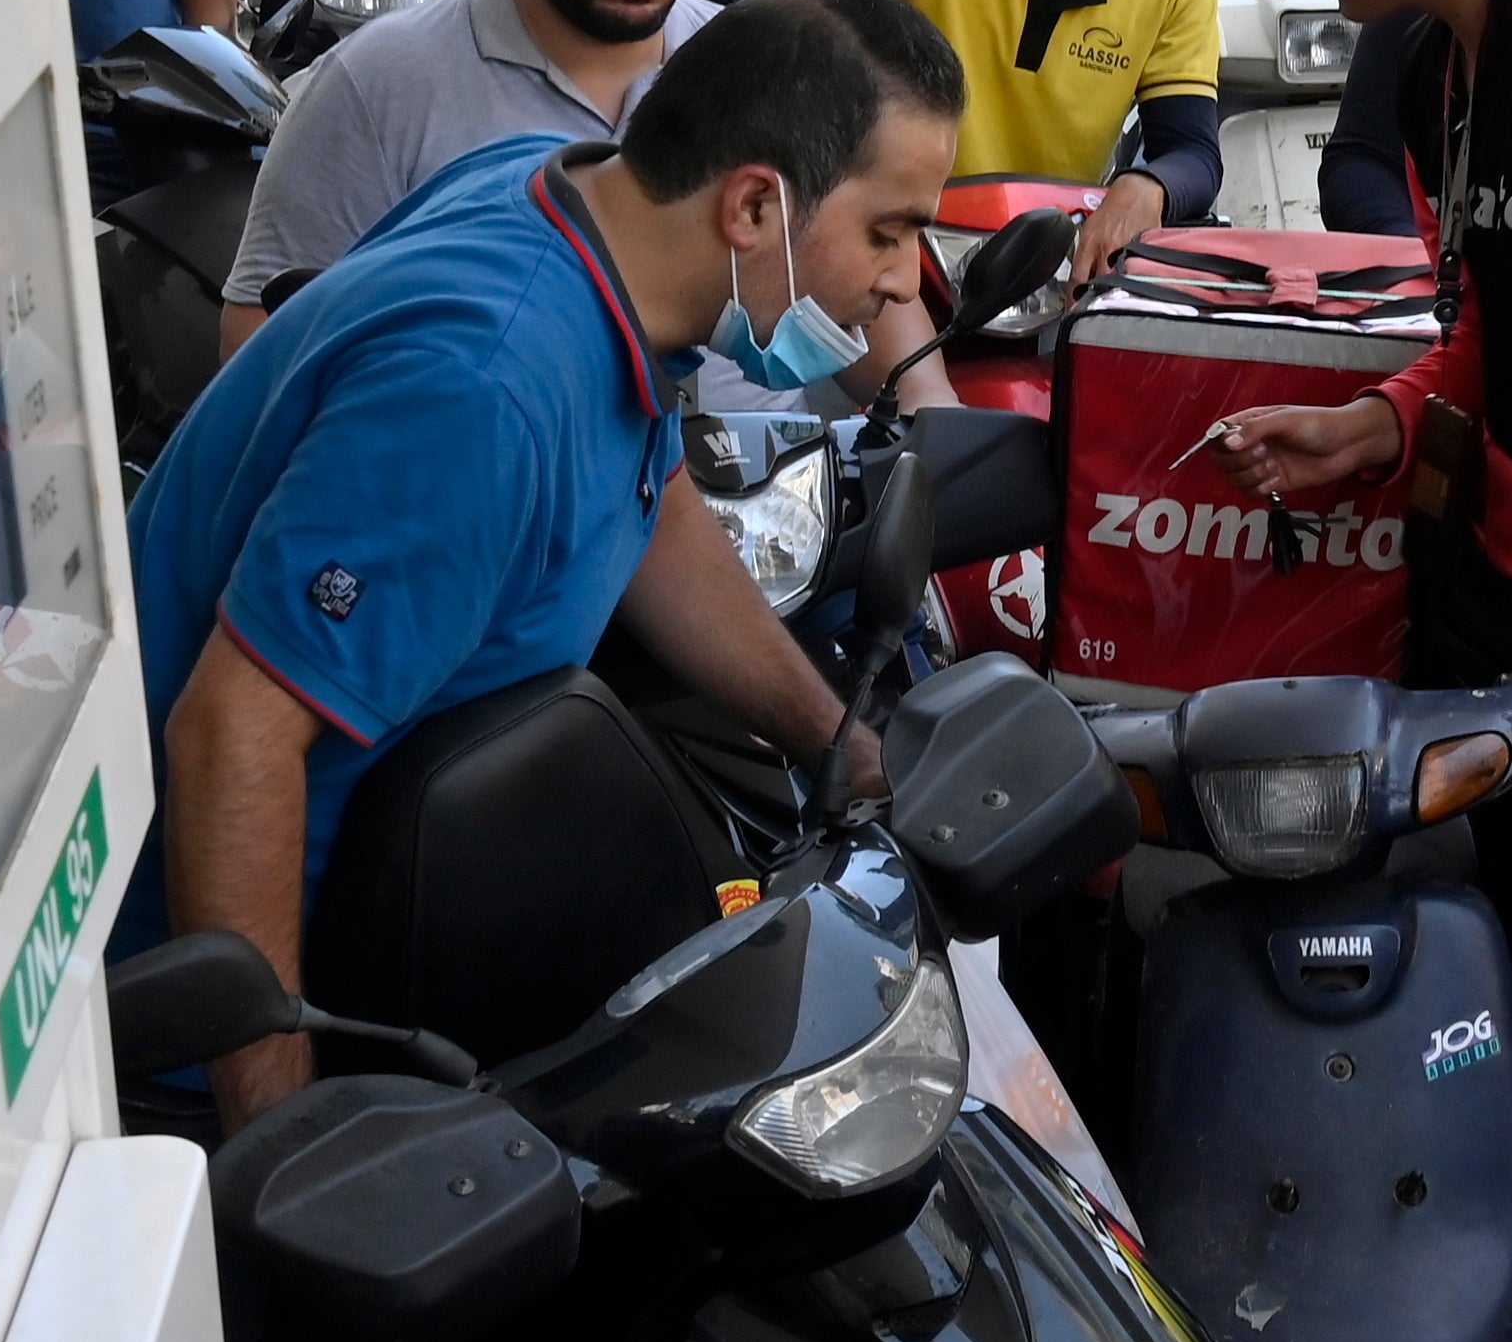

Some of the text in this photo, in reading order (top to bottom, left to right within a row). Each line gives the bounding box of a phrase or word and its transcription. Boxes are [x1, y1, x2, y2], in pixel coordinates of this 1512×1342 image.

[1068, 41, 1131, 70] CLASSIC
[1078, 635, 1117, 663] 619
[11, 810, 96, 1052] UNL 95
[1298, 936, 1374, 957] YAMAHA
[1425, 1009, 1494, 1065] JOG
